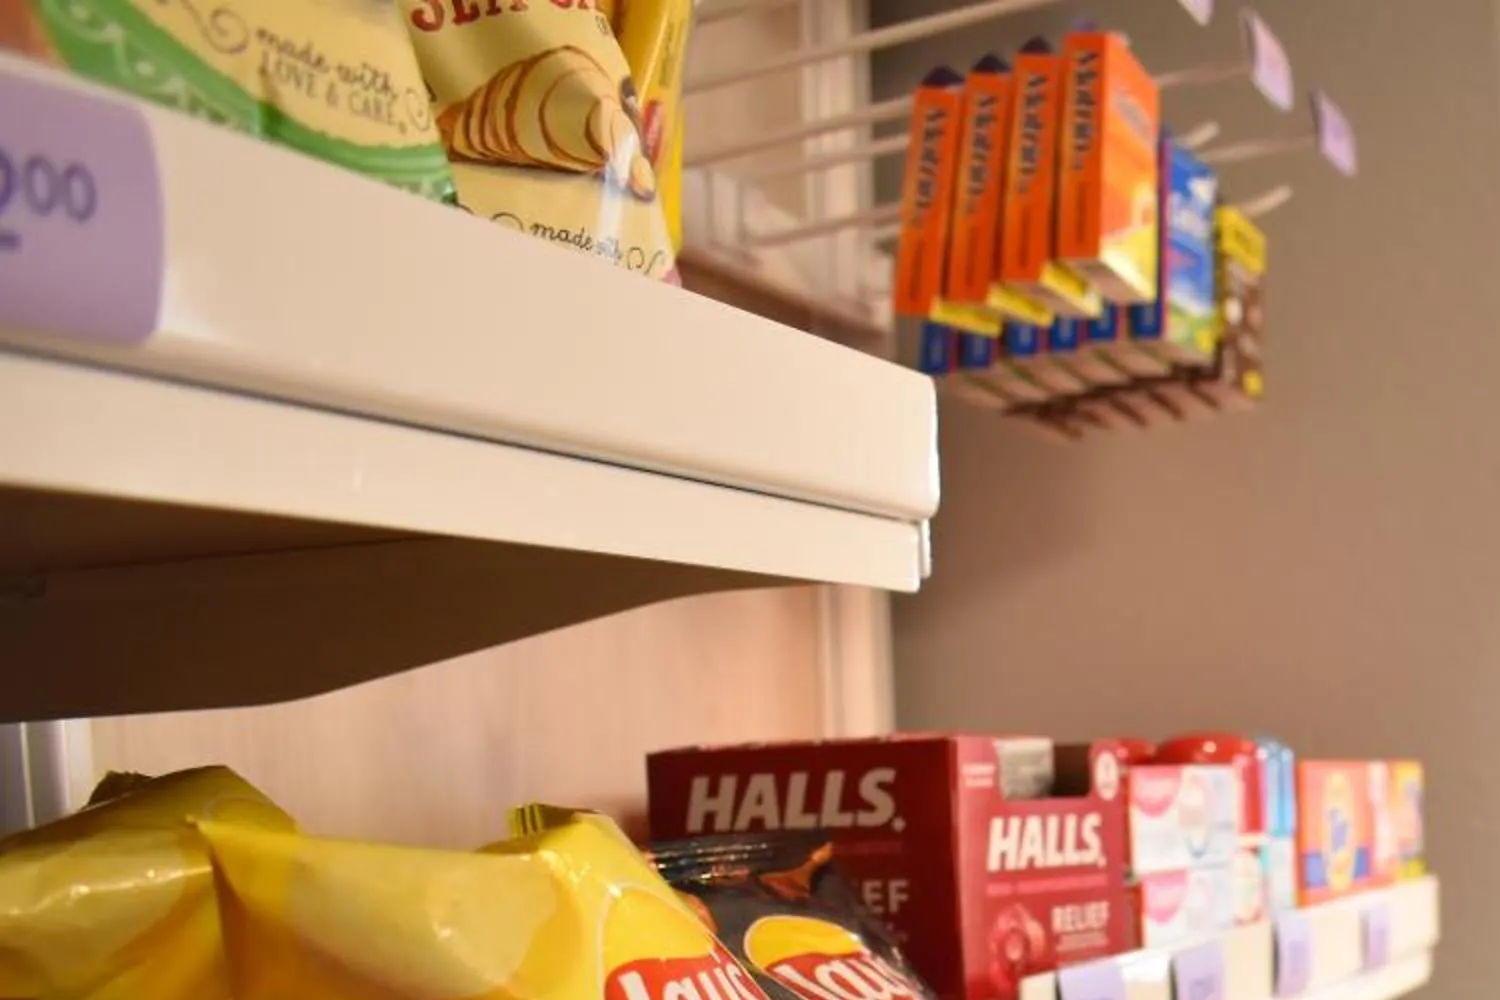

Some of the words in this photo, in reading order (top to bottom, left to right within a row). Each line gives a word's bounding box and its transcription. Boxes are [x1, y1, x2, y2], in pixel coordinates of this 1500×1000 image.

[529, 222, 593, 251] made
[686, 767, 899, 832] HALLS
[987, 812, 1104, 872] HALLS
[1052, 901, 1110, 934] RELIEF
